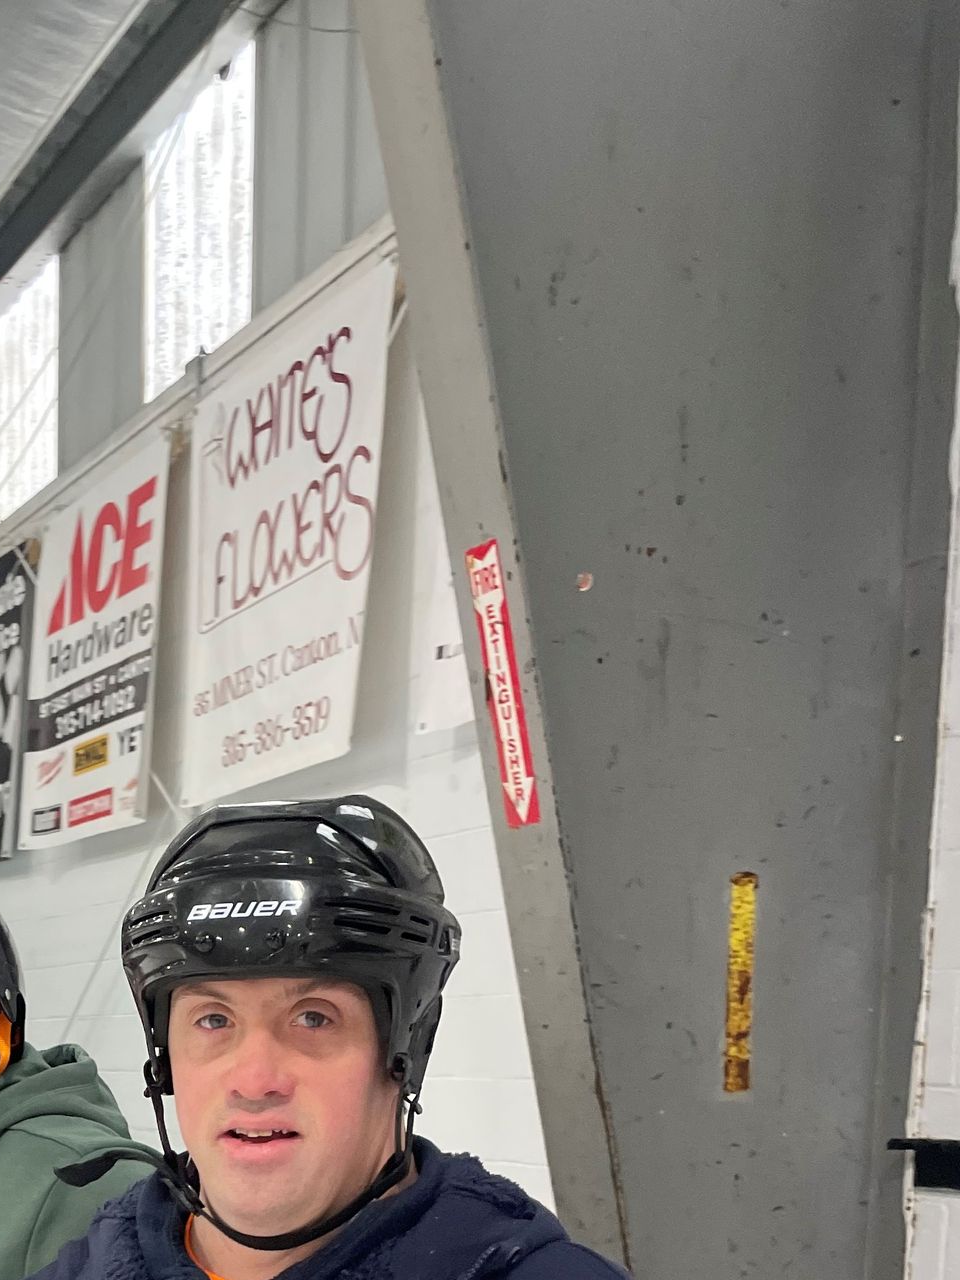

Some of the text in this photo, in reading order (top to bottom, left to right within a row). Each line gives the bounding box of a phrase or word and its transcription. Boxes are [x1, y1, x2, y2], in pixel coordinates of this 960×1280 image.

[47, 475, 159, 637] ACE
[213, 445, 375, 618] FLOWERS
[472, 563, 499, 600] FIRE
[47, 602, 155, 683] Hardware
[485, 603, 525, 802] EXTINGUISHER
[186, 899, 304, 922] BAUER
